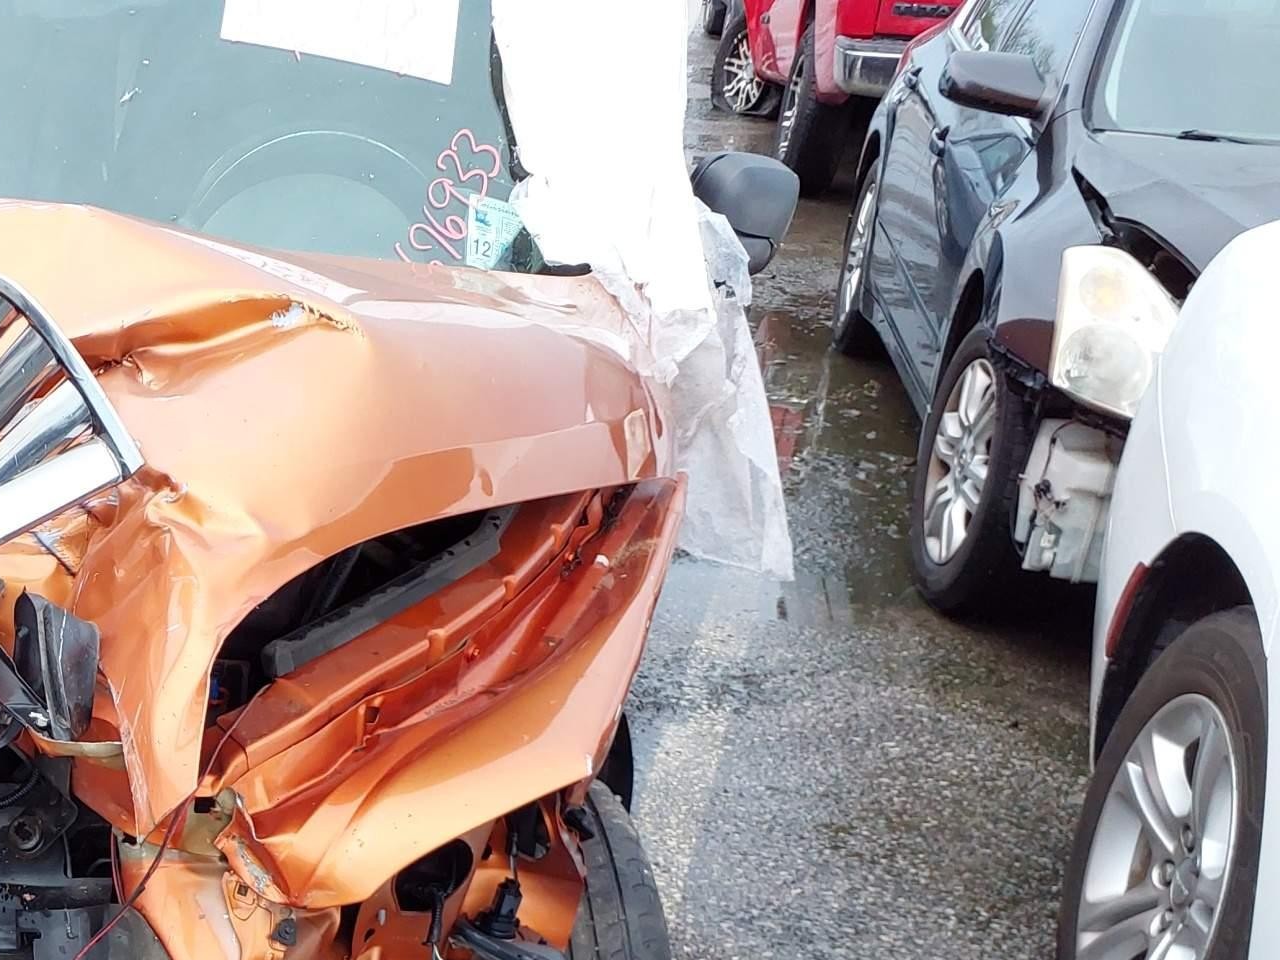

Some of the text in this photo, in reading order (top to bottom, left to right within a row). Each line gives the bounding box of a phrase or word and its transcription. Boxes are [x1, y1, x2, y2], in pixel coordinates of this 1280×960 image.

[893, 3, 955, 18] TITA
[394, 128, 500, 267] 76933
[473, 239, 492, 258] 12
